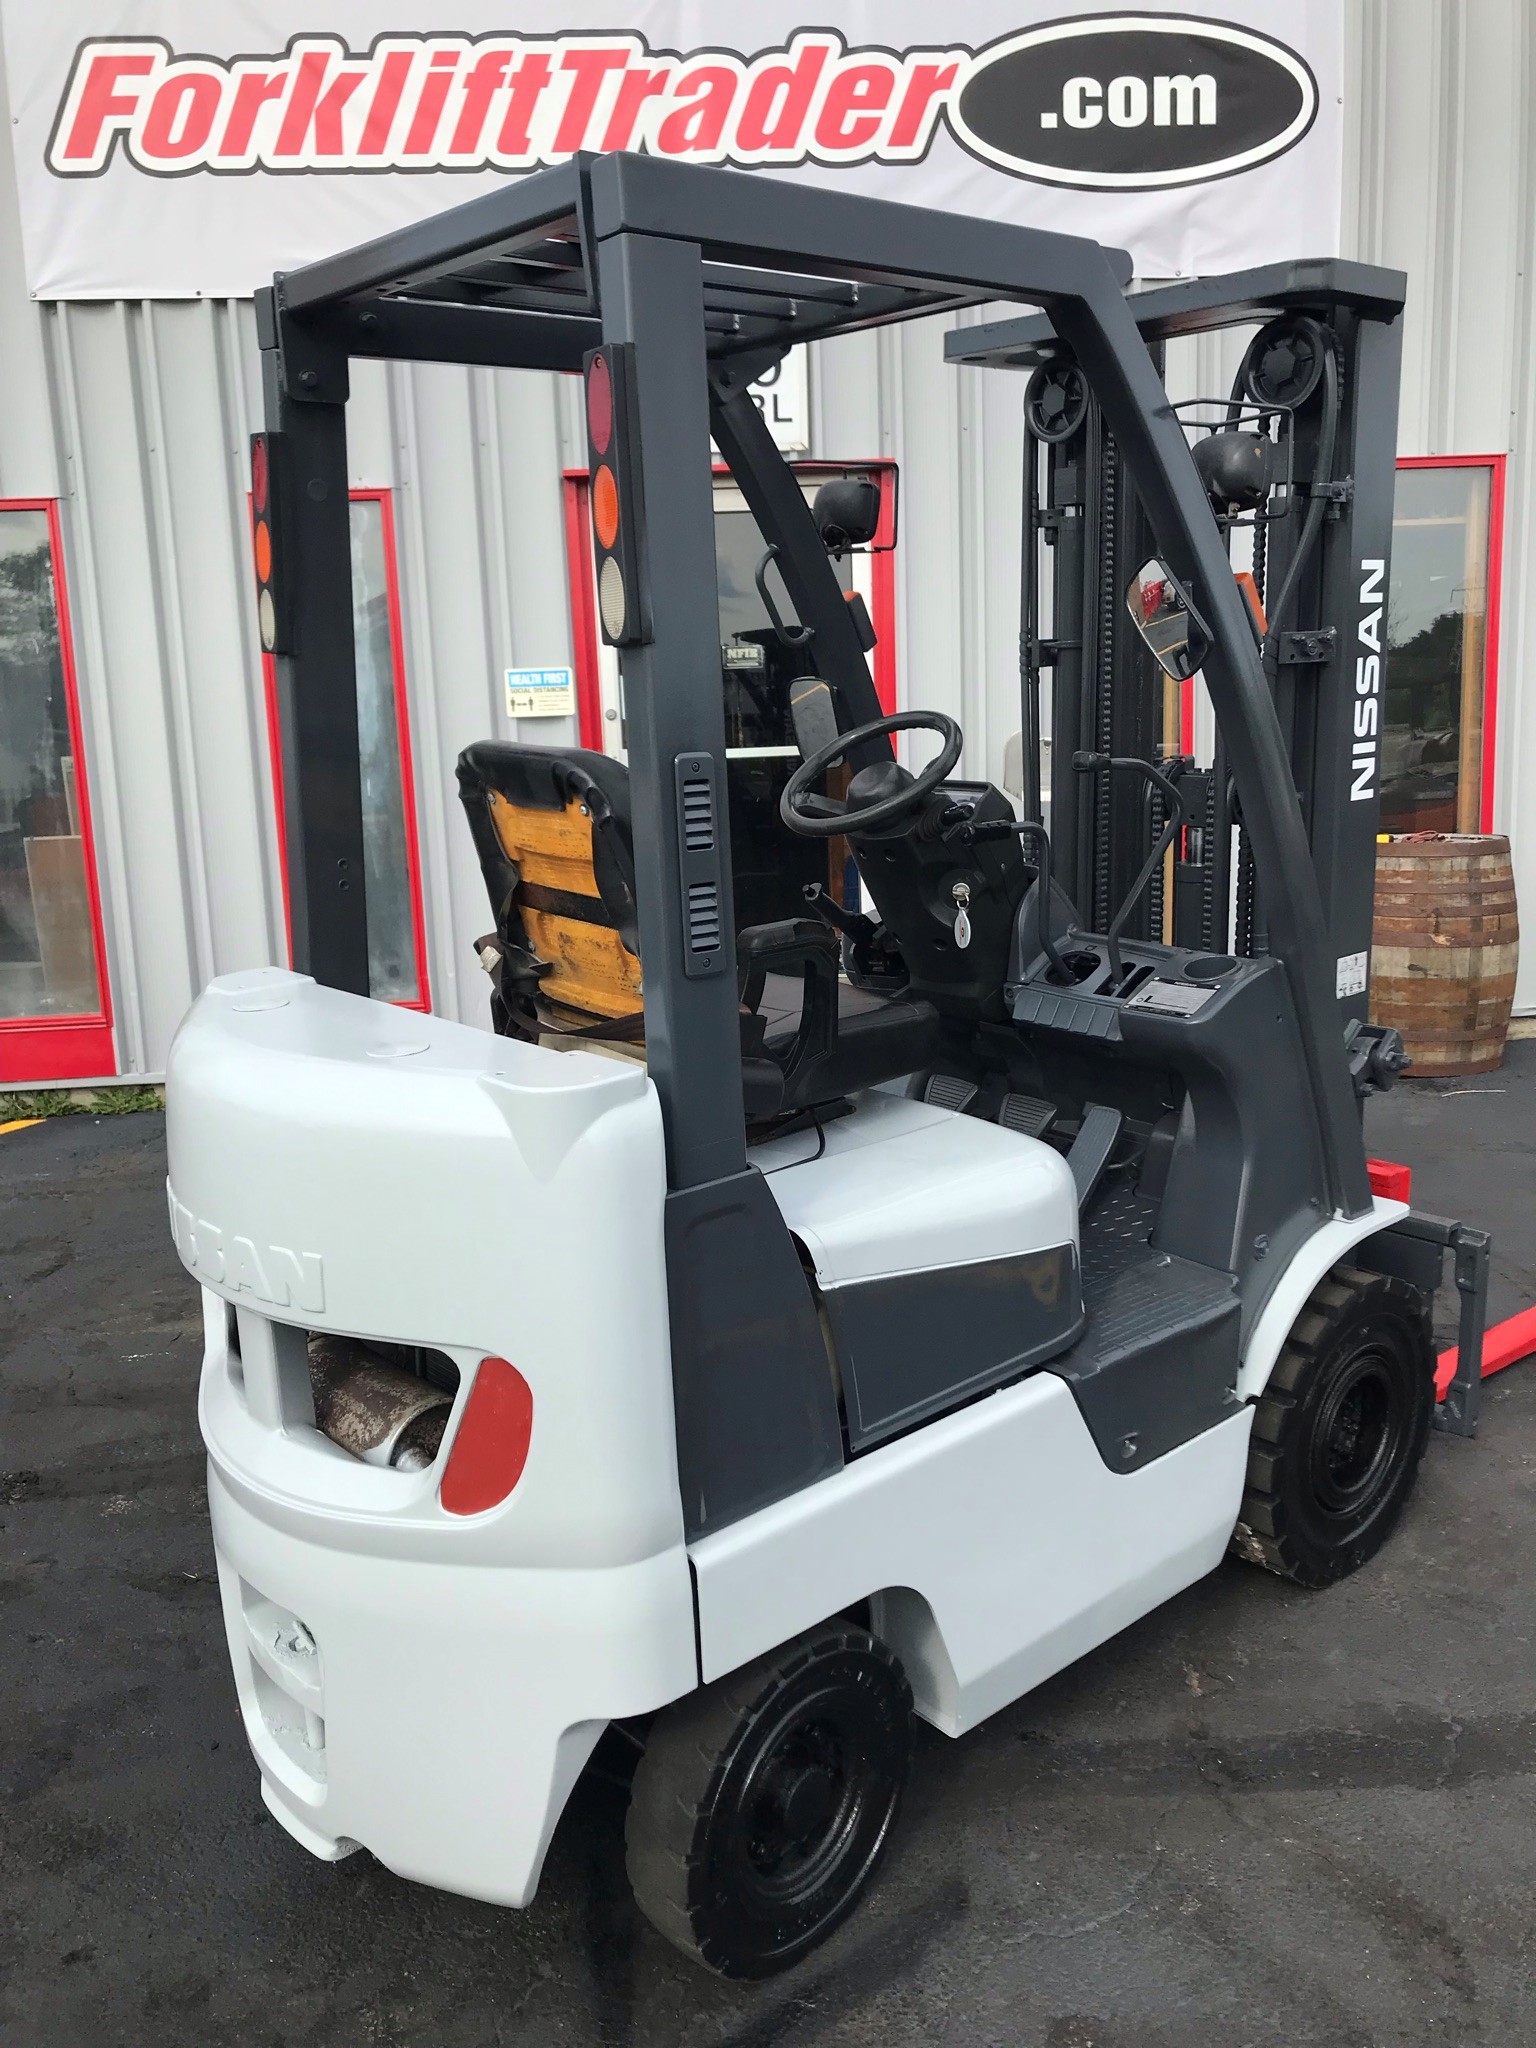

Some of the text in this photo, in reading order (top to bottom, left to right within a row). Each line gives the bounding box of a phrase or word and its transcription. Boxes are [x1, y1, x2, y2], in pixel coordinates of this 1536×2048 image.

[65, 46, 1216, 158] ForkliftTrader .com
[1351, 559, 1386, 802] NISSAN
